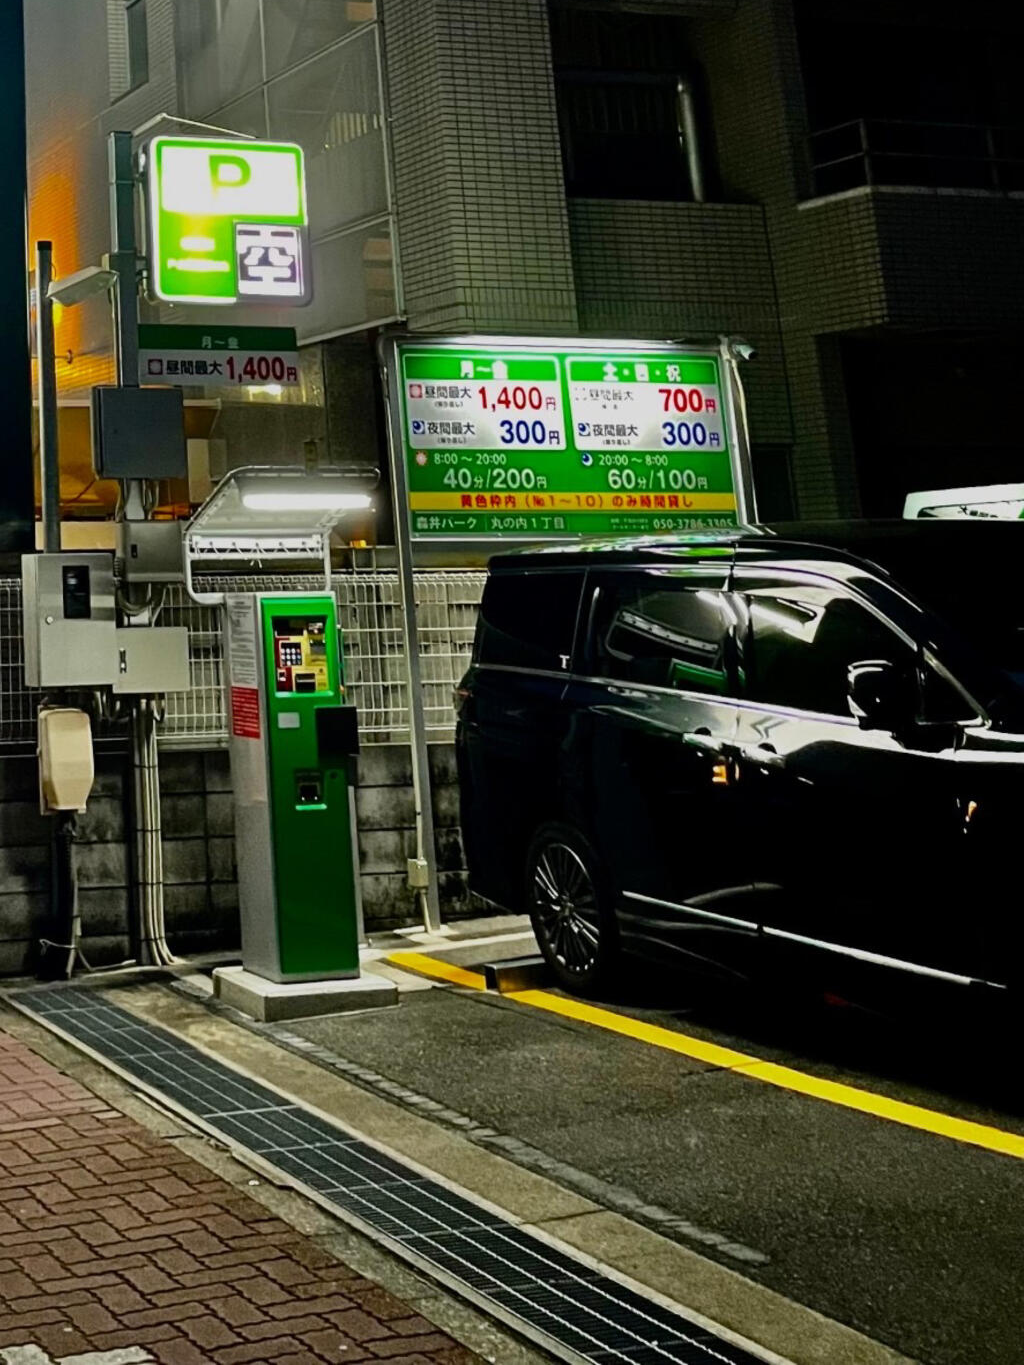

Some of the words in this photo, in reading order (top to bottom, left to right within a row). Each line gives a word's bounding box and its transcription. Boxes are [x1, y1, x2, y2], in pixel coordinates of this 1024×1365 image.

[208, 153, 252, 201] P
[237, 224, 301, 294] 空
[166, 359, 224, 376] 昼間最大
[226, 355, 299, 384] 1,400円
[424, 385, 473, 400] 昼間最大
[478, 385, 557, 413] 1,400円
[658, 388, 717, 414] 700円
[427, 421, 476, 436] 夜間最大
[499, 419, 561, 446] 300円
[592, 423, 639, 437] 夜間最大
[662, 421, 721, 448] 300円
[433, 453, 459, 465] 8:00
[475, 453, 507, 465] 20:00
[597, 454, 629, 466] 20:00
[645, 454, 669, 466] 8:00
[443, 467, 548, 489] 40分/200円
[607, 468, 709, 490] 60分/100円
